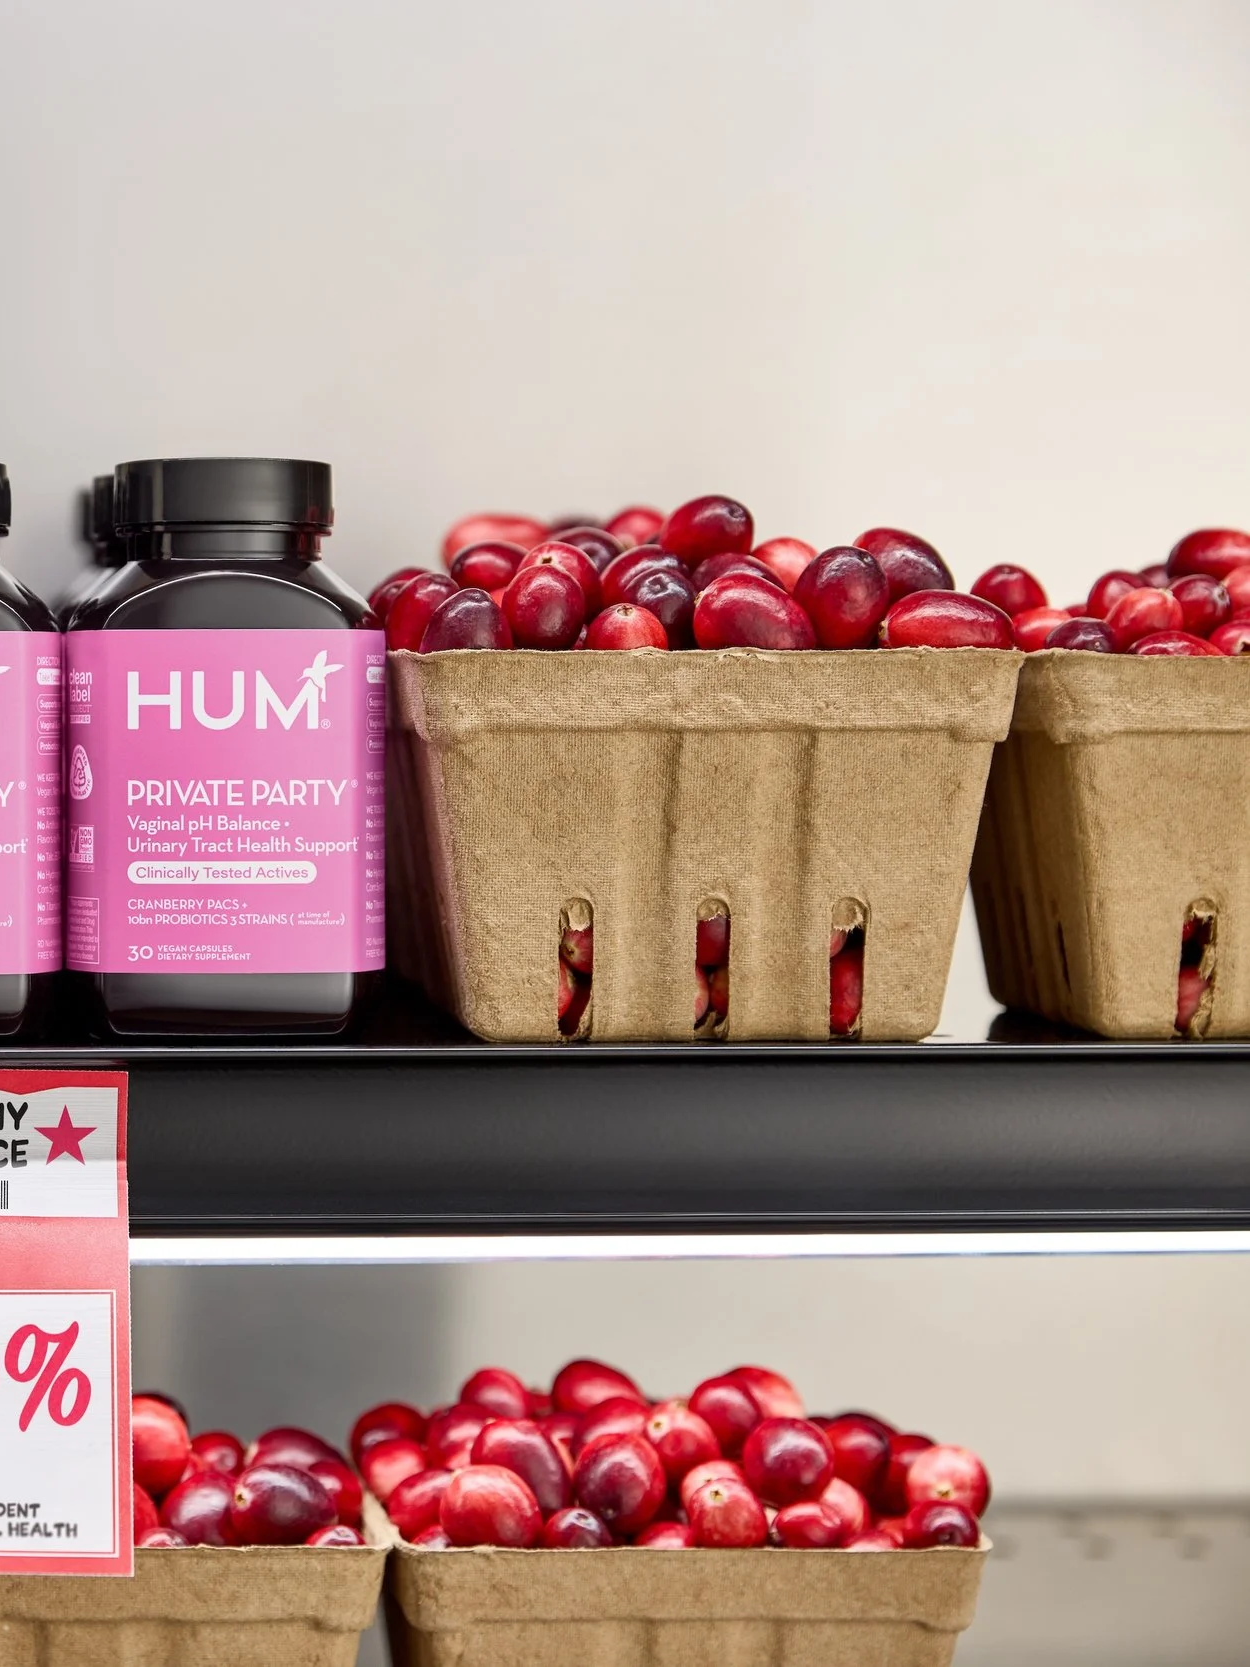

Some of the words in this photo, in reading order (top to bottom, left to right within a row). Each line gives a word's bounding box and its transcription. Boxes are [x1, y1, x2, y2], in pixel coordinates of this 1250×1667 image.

[127, 779, 244, 807] PRIVATE
[36, 820, 46, 830] No
[127, 815, 185, 835] Vaginal
[188, 816, 213, 835] pH
[217, 815, 281, 831] Balance
[127, 836, 186, 857] Urinary
[191, 837, 234, 853] Tract
[237, 836, 291, 853] Health
[36, 852, 46, 862] No
[36, 870, 46, 880] No
[135, 866, 200, 881] Clinically
[203, 866, 252, 879] Tested
[255, 866, 309, 879] Actives
[37, 902, 46, 912] No
[127, 898, 205, 911] CRANBERRY
[207, 898, 240, 910] PACS
[127, 913, 153, 925] 10bn
[155, 913, 228, 925] PROBIOTICS
[230, 914, 237, 927] 3
[238, 913, 288, 925] STRAINS
[322, 910, 330, 918] of
[127, 945, 154, 961] 30
[157, 953, 194, 961] DIETARY
[195, 953, 251, 961] SUPPLEMENT
[8, 1522, 78, 1539] HEALTH
